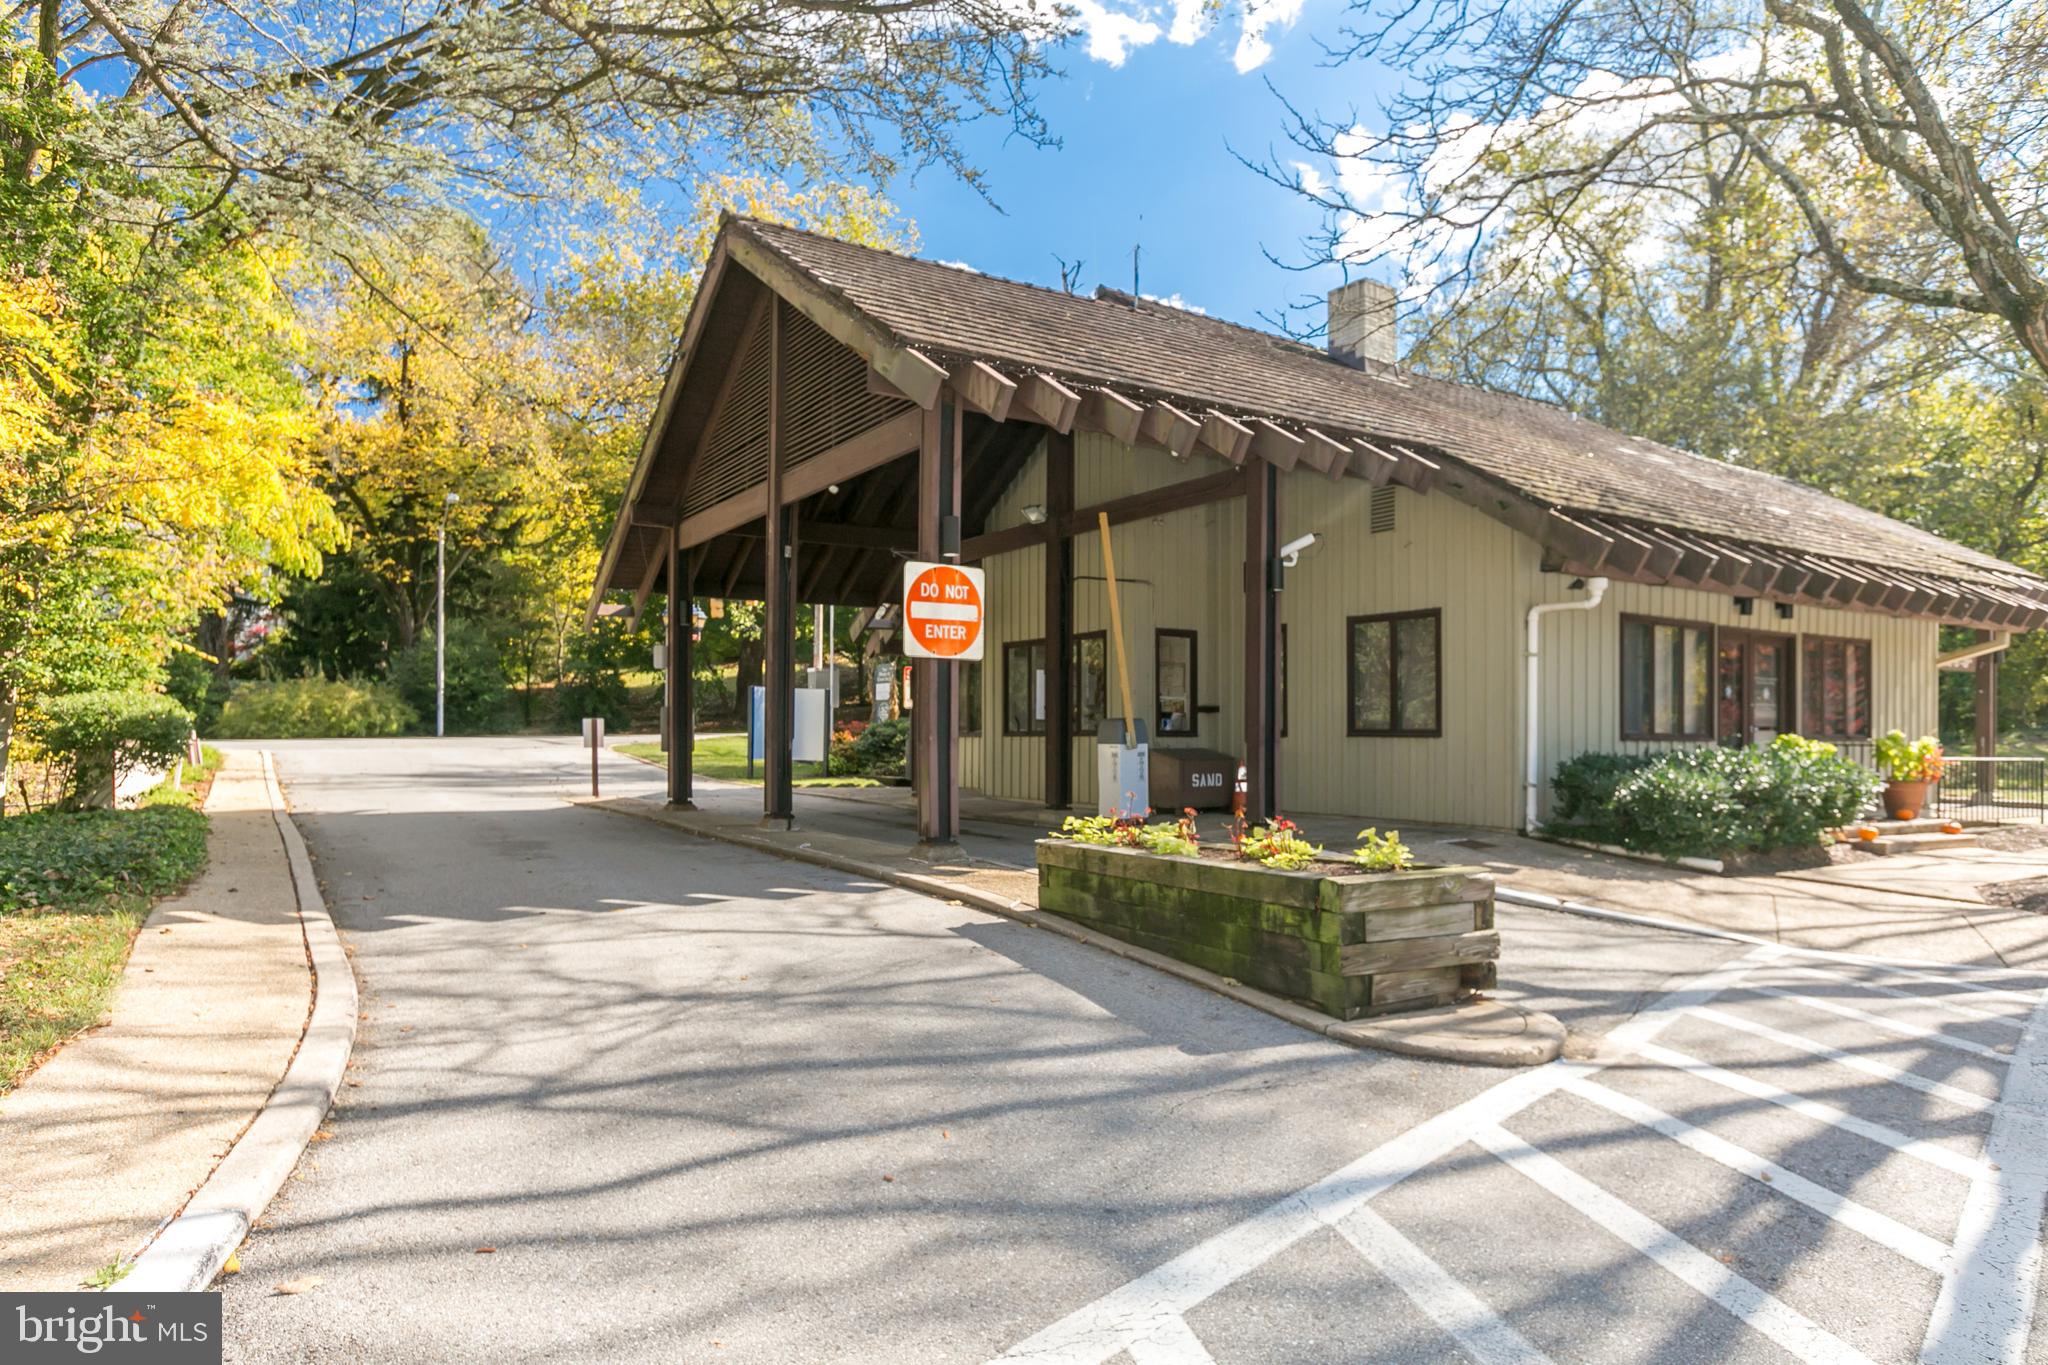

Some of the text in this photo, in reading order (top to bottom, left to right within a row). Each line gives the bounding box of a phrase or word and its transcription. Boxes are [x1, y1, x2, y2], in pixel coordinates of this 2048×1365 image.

[920, 582, 970, 600] DO NOT
[925, 624, 967, 640] ENTER
[1192, 773, 1223, 788] SAND
